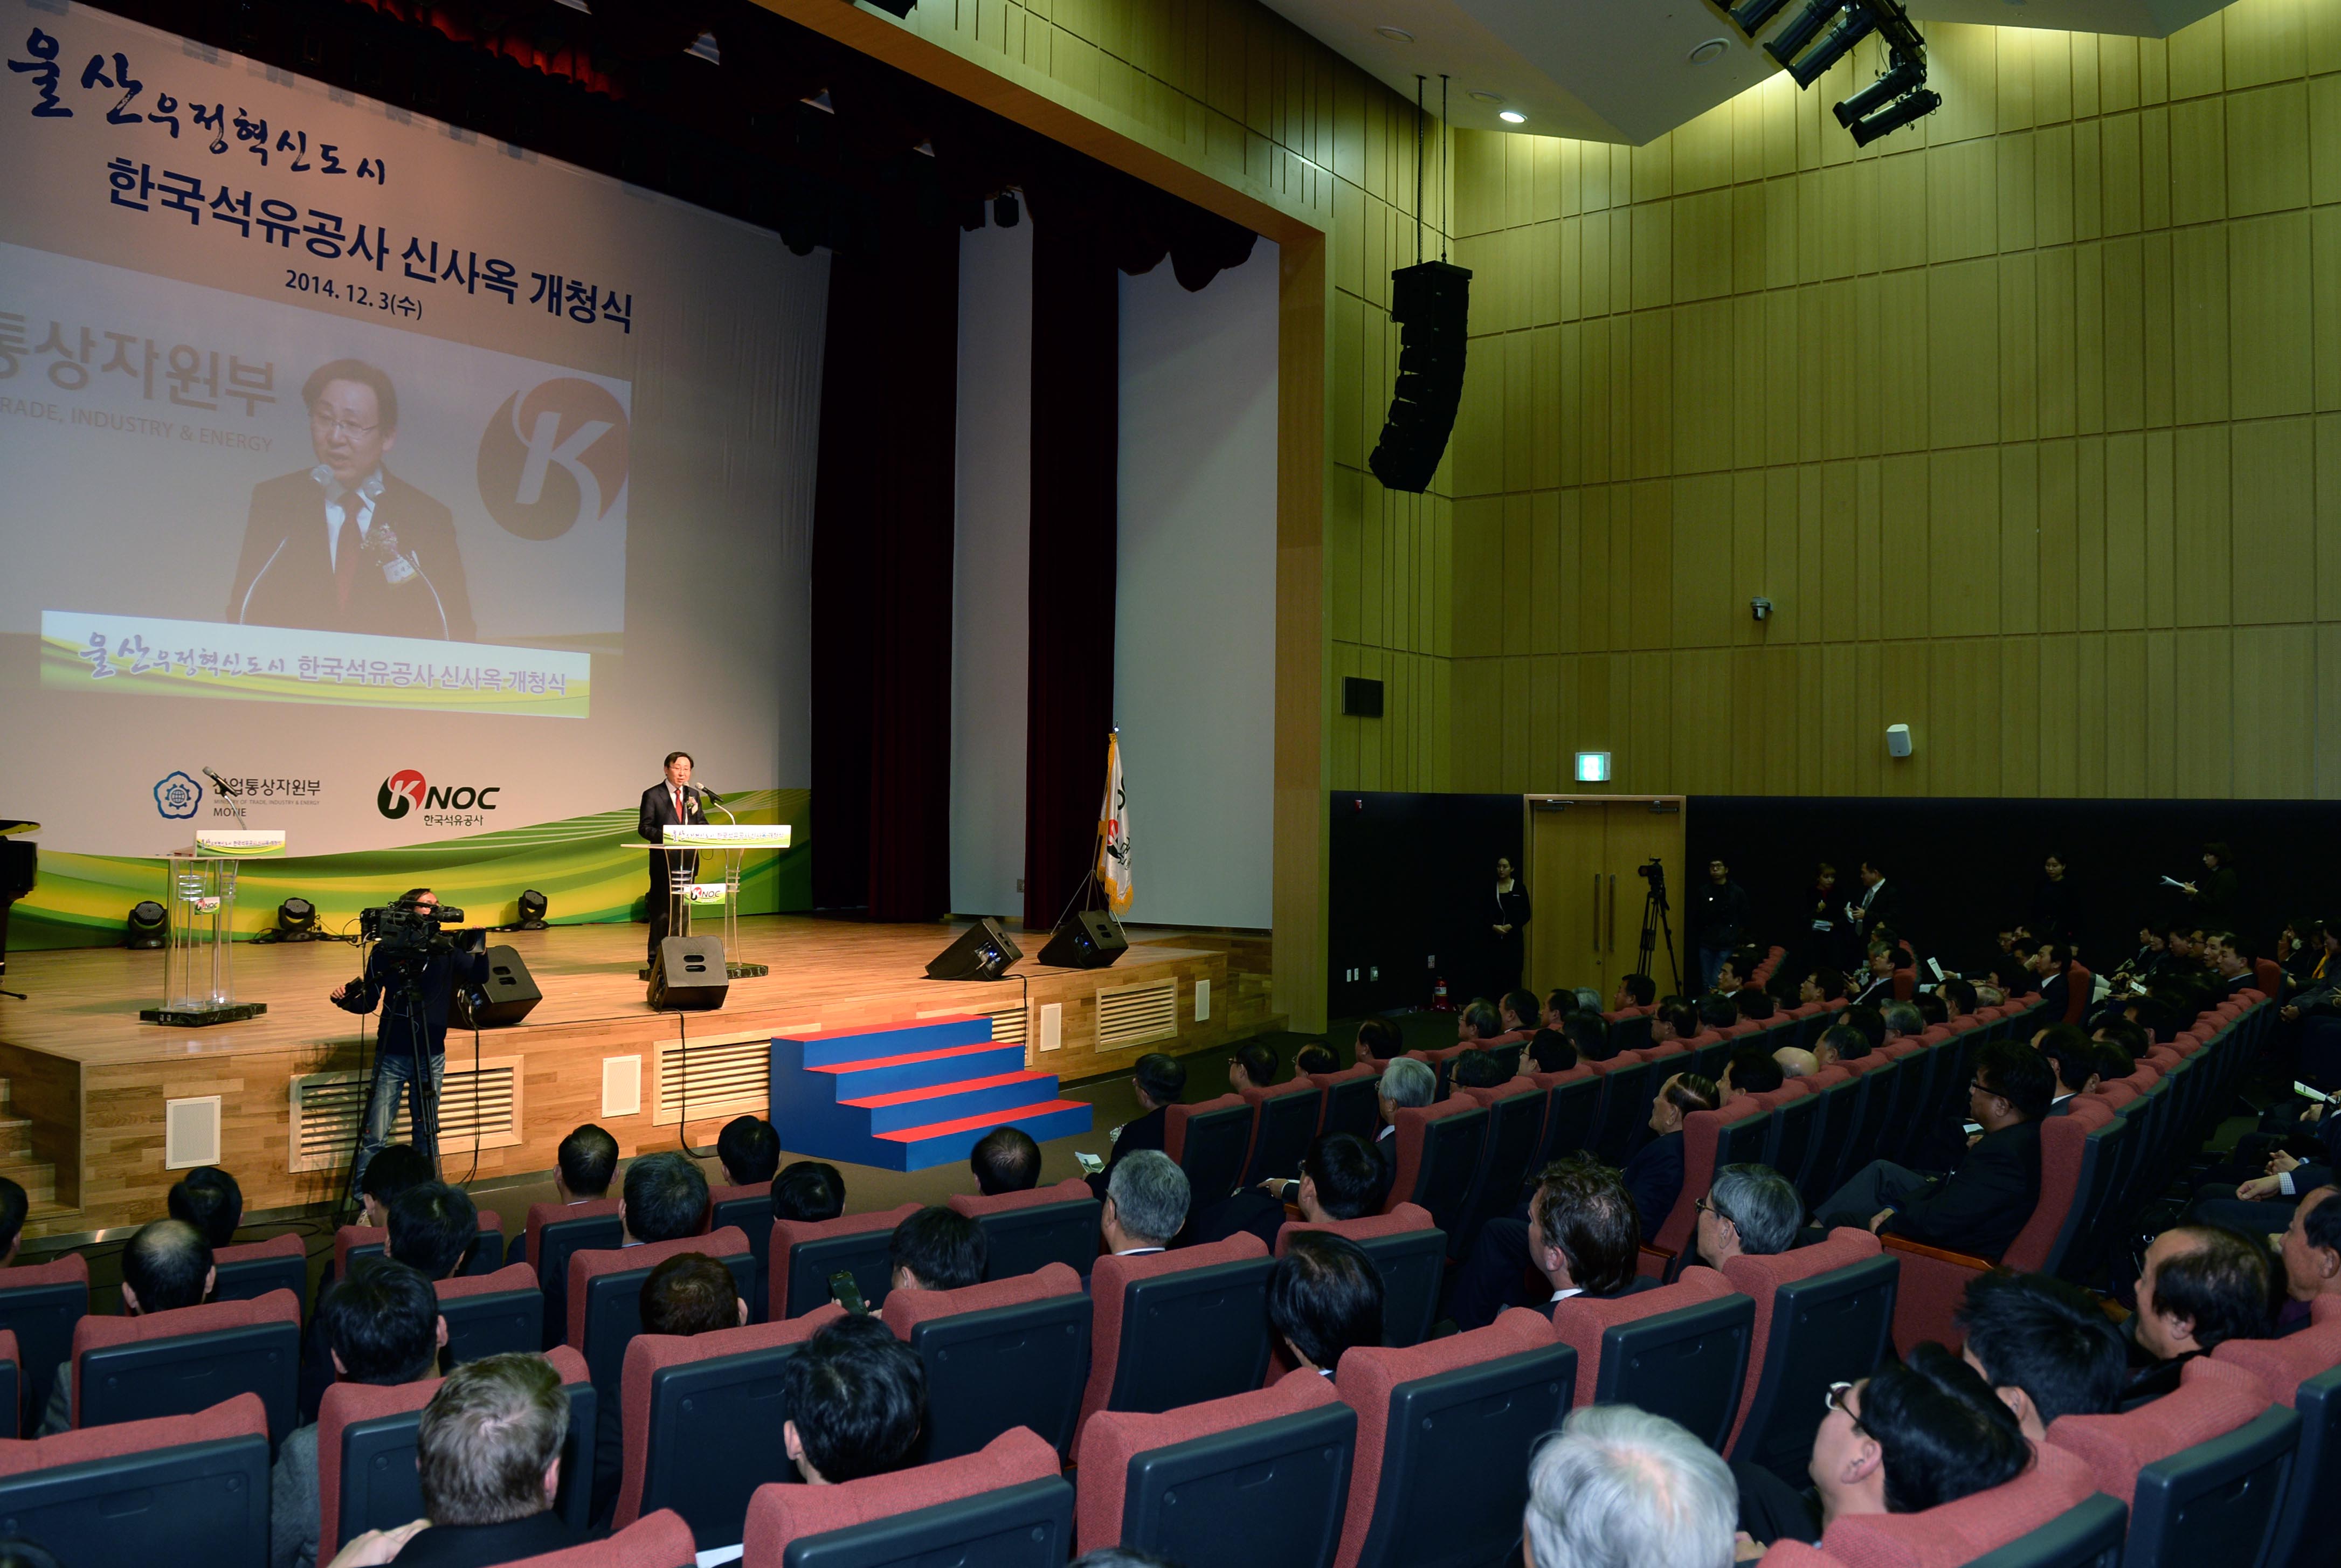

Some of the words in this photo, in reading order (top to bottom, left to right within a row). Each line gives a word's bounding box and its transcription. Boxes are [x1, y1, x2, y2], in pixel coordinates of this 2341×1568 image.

[107, 157, 389, 271] 한국석유공사
[401, 236, 519, 305] 신사옥
[530, 271, 633, 334] 개청식
[71, 407, 173, 438] INDUSTRY
[179, 425, 192, 442] &
[200, 428, 272, 452] ENERGY
[298, 655, 434, 688] 한국석유공사
[440, 665, 502, 692] 신사옥
[508, 671, 566, 695] 개청식
[424, 814, 484, 826] 한국석유공사
